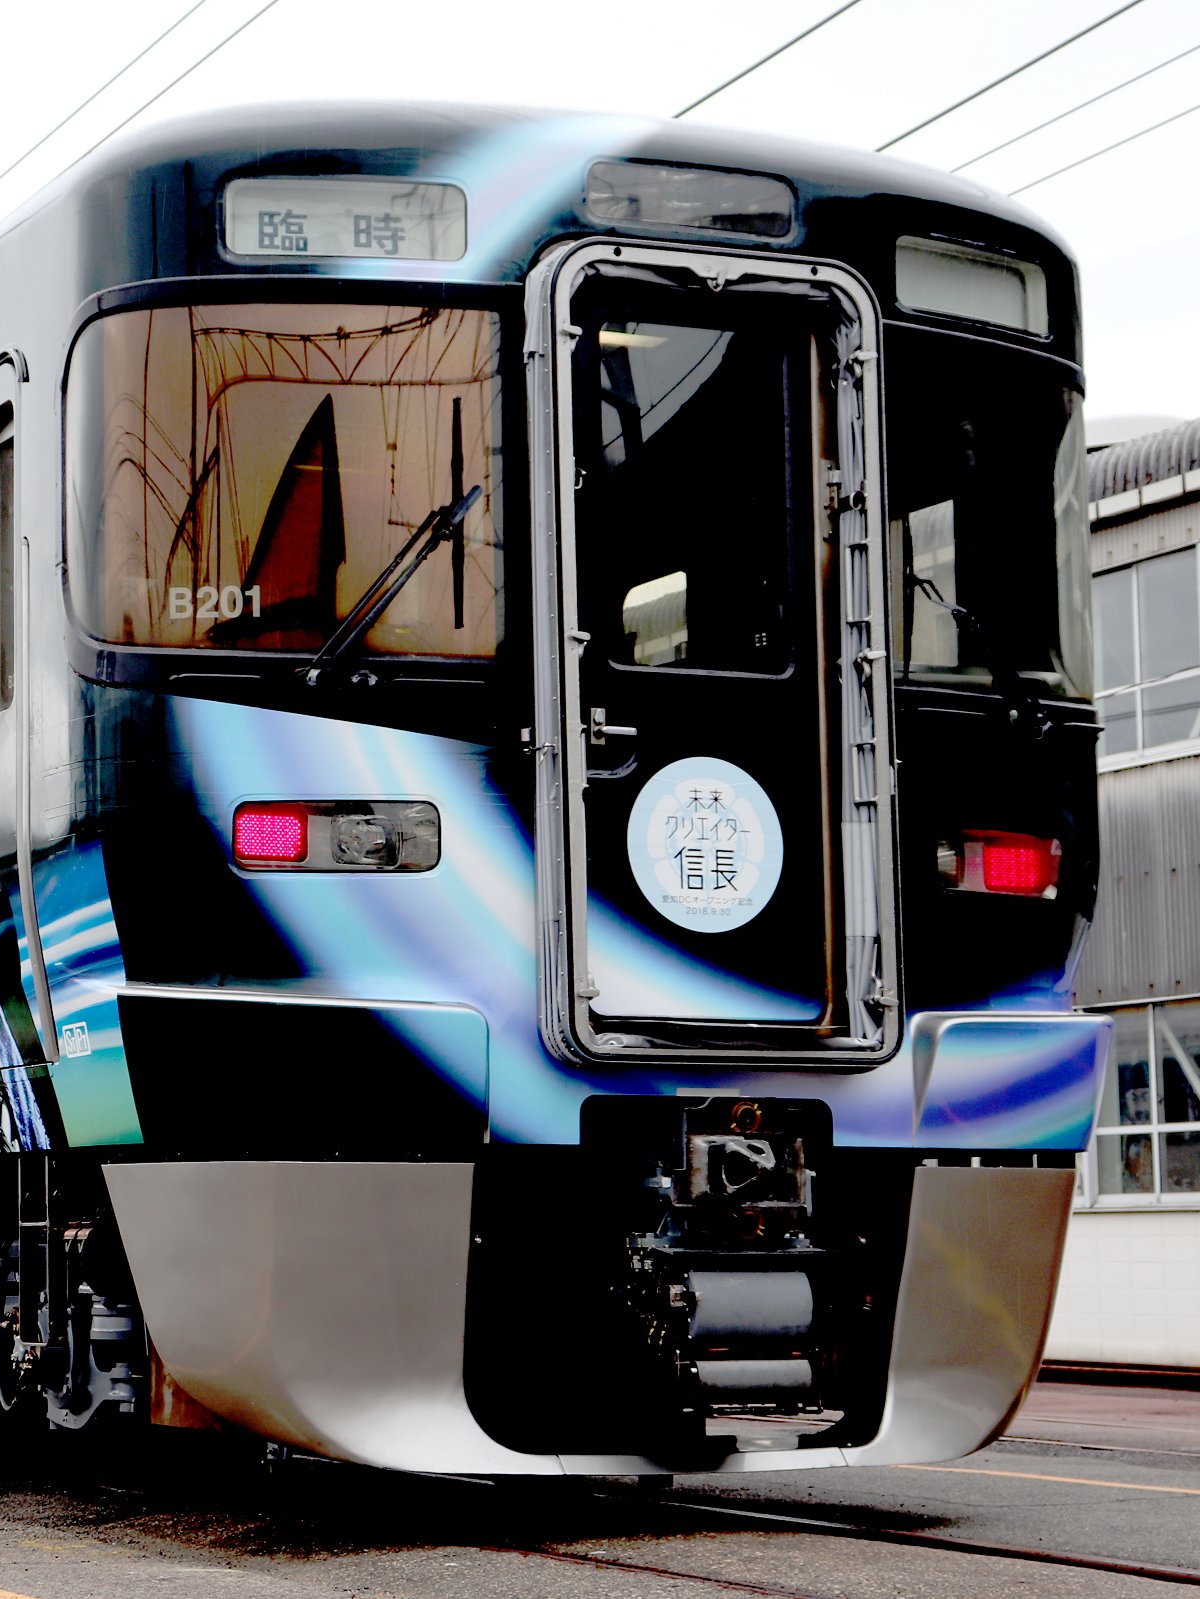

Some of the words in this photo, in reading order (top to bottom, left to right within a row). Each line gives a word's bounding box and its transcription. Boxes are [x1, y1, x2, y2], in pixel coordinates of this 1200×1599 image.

[168, 584, 261, 620] B201
[686, 787, 726, 814] 未来
[665, 815, 751, 841] クリエイター
[673, 846, 738, 891] 信長
[686, 906, 731, 916] 2018.9.30
